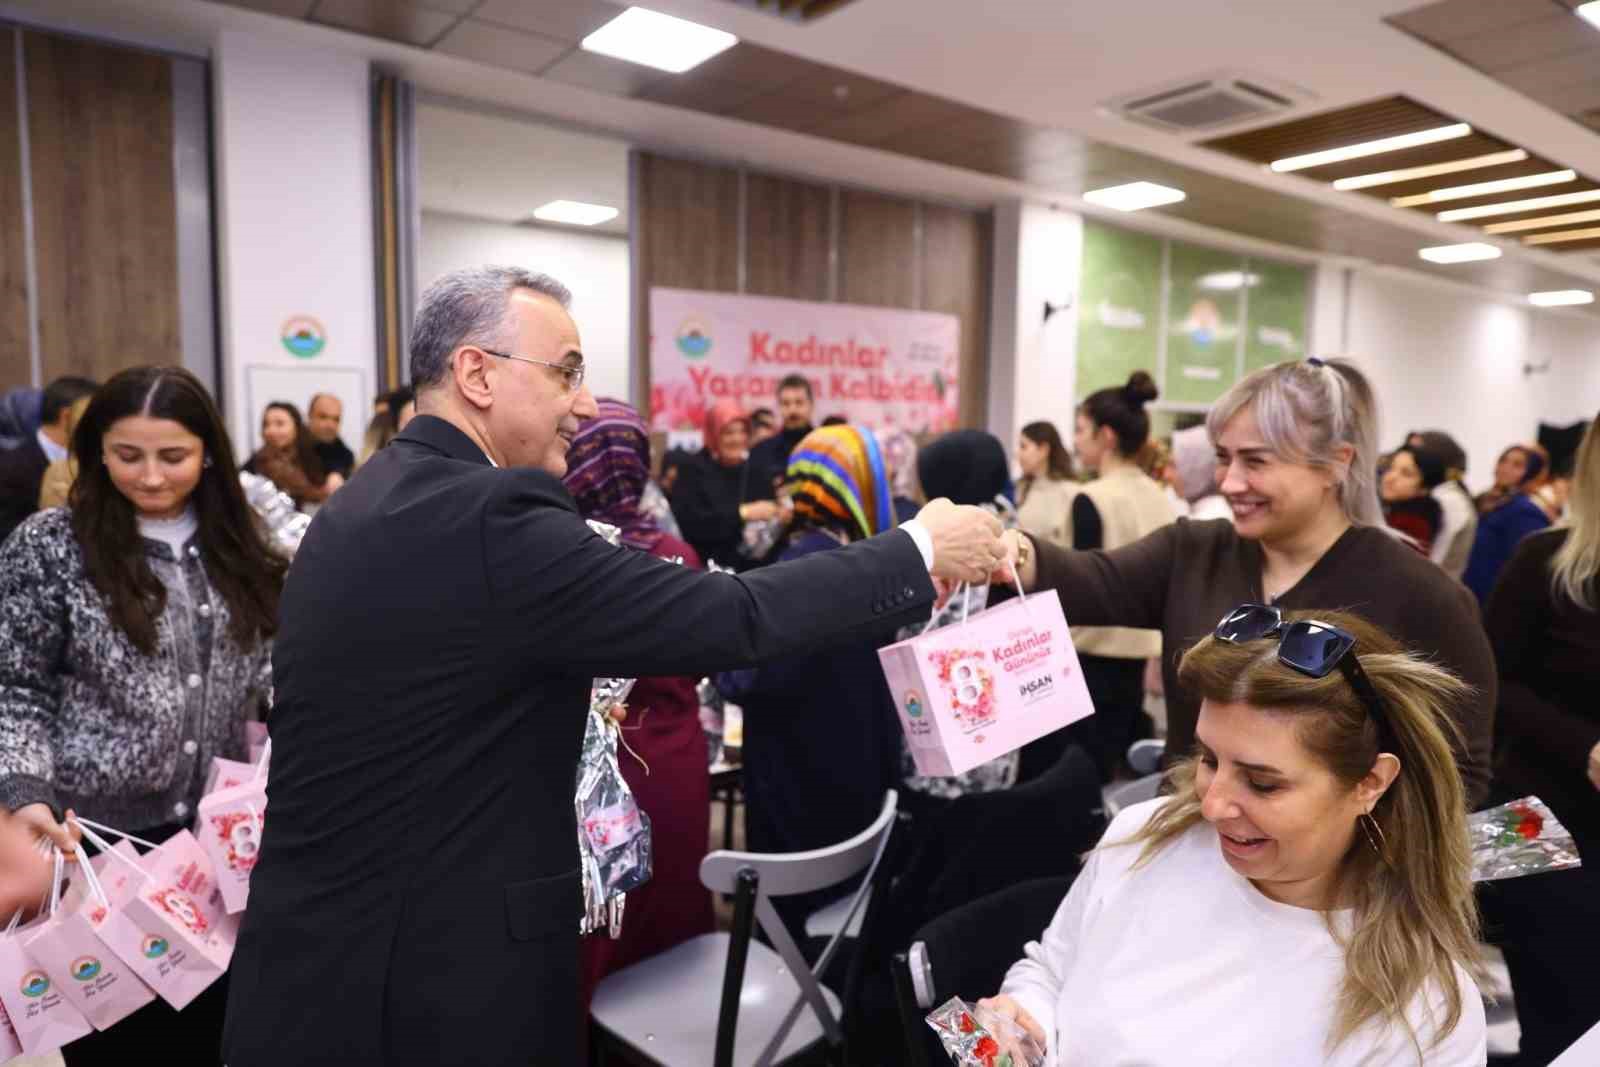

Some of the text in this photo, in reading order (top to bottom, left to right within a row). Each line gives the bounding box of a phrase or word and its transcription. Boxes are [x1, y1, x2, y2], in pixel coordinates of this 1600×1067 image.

[750, 331, 889, 369] Kadınlar
[688, 367, 822, 404] Yaşan
[992, 629, 1052, 664] Kadınlar
